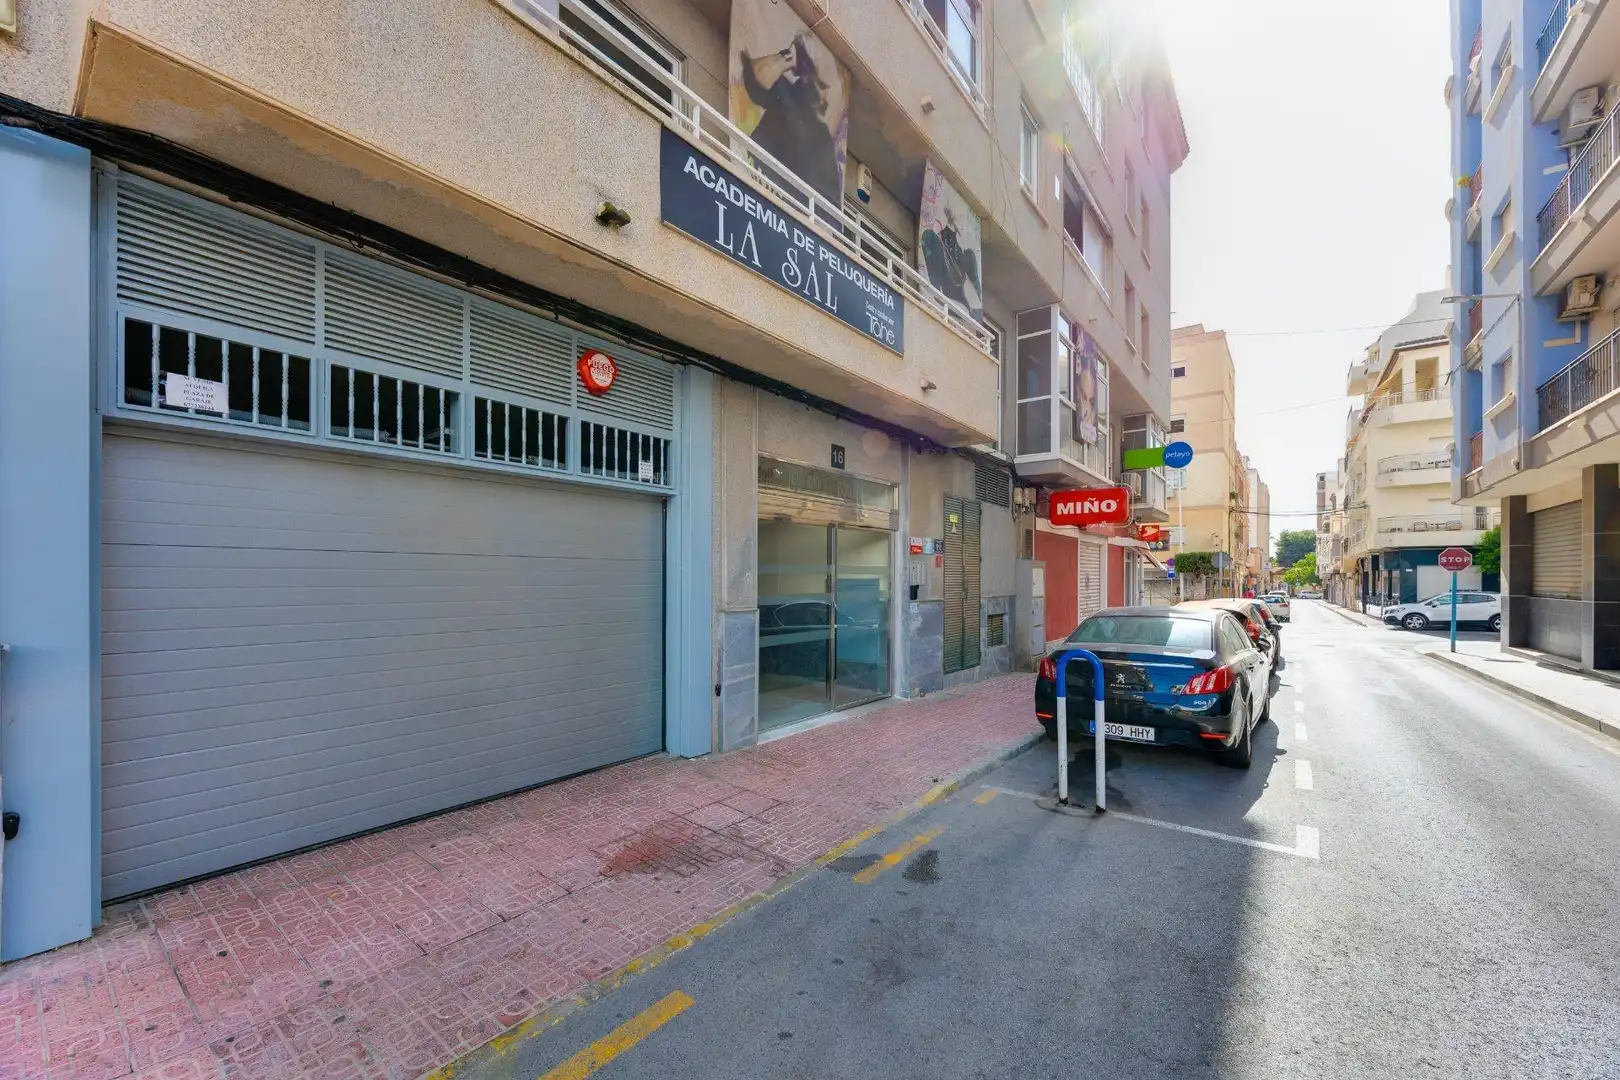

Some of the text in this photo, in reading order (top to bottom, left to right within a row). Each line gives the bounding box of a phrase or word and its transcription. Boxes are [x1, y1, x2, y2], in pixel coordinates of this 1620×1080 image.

[683, 156, 895, 311] ACADEMIA DE PELUQUERÍA
[714, 200, 838, 314] LA SAL
[587, 358, 614, 374] FUEGO
[833, 451, 844, 464] 16
[1165, 450, 1191, 460] pelayo
[1056, 497, 1117, 515] MIÑO
[1103, 723, 1124, 735] 309
[1130, 727, 1151, 739] HHY
